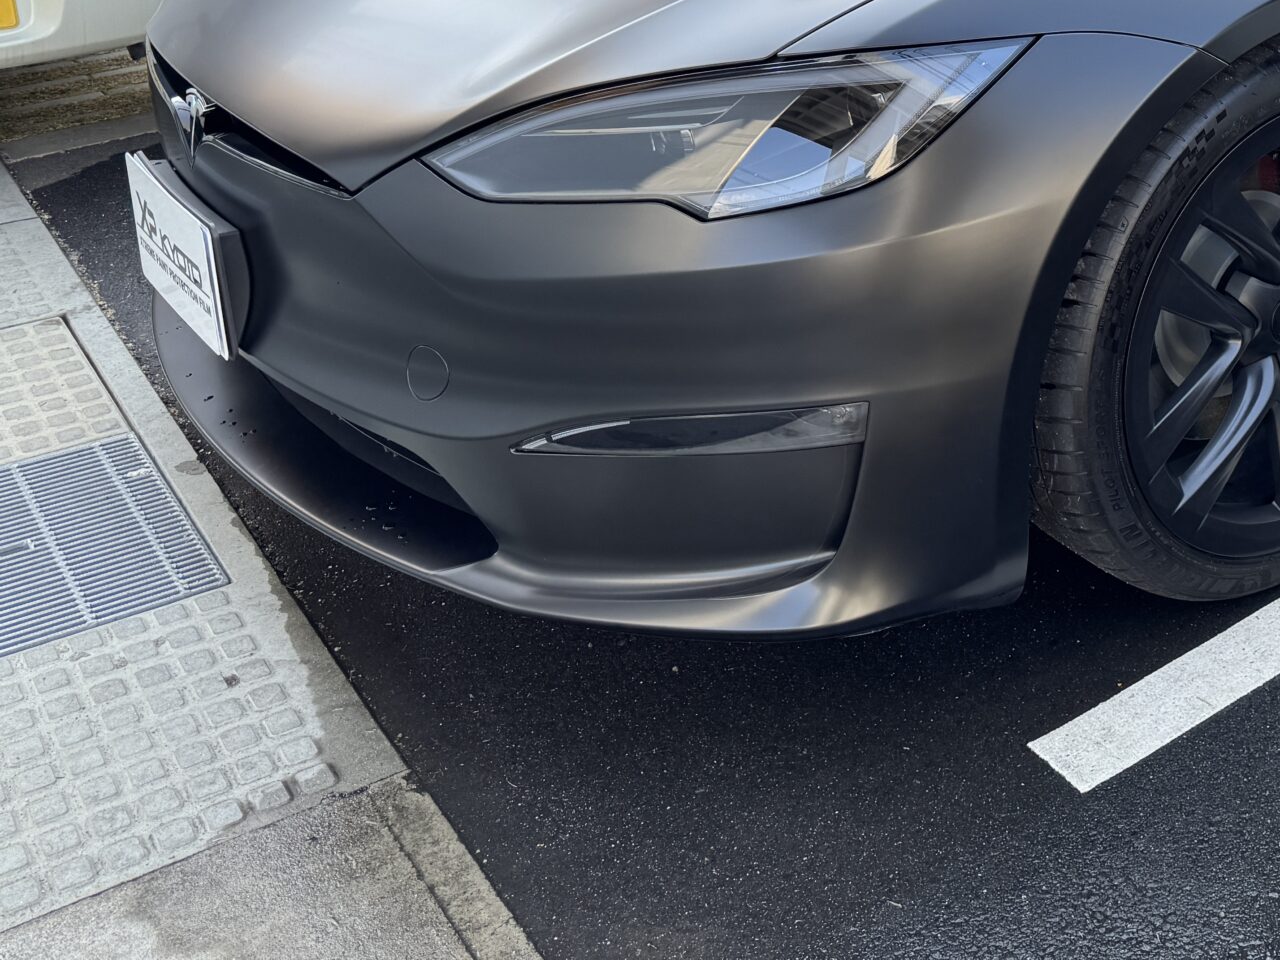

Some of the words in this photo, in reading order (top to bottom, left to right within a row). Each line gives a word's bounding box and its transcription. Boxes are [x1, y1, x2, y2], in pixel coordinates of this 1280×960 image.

[158, 228, 202, 291] KYOTO
[169, 267, 199, 306] PROTECTION
[199, 297, 212, 318] FILM
[1101, 468, 1125, 512] PILOT
